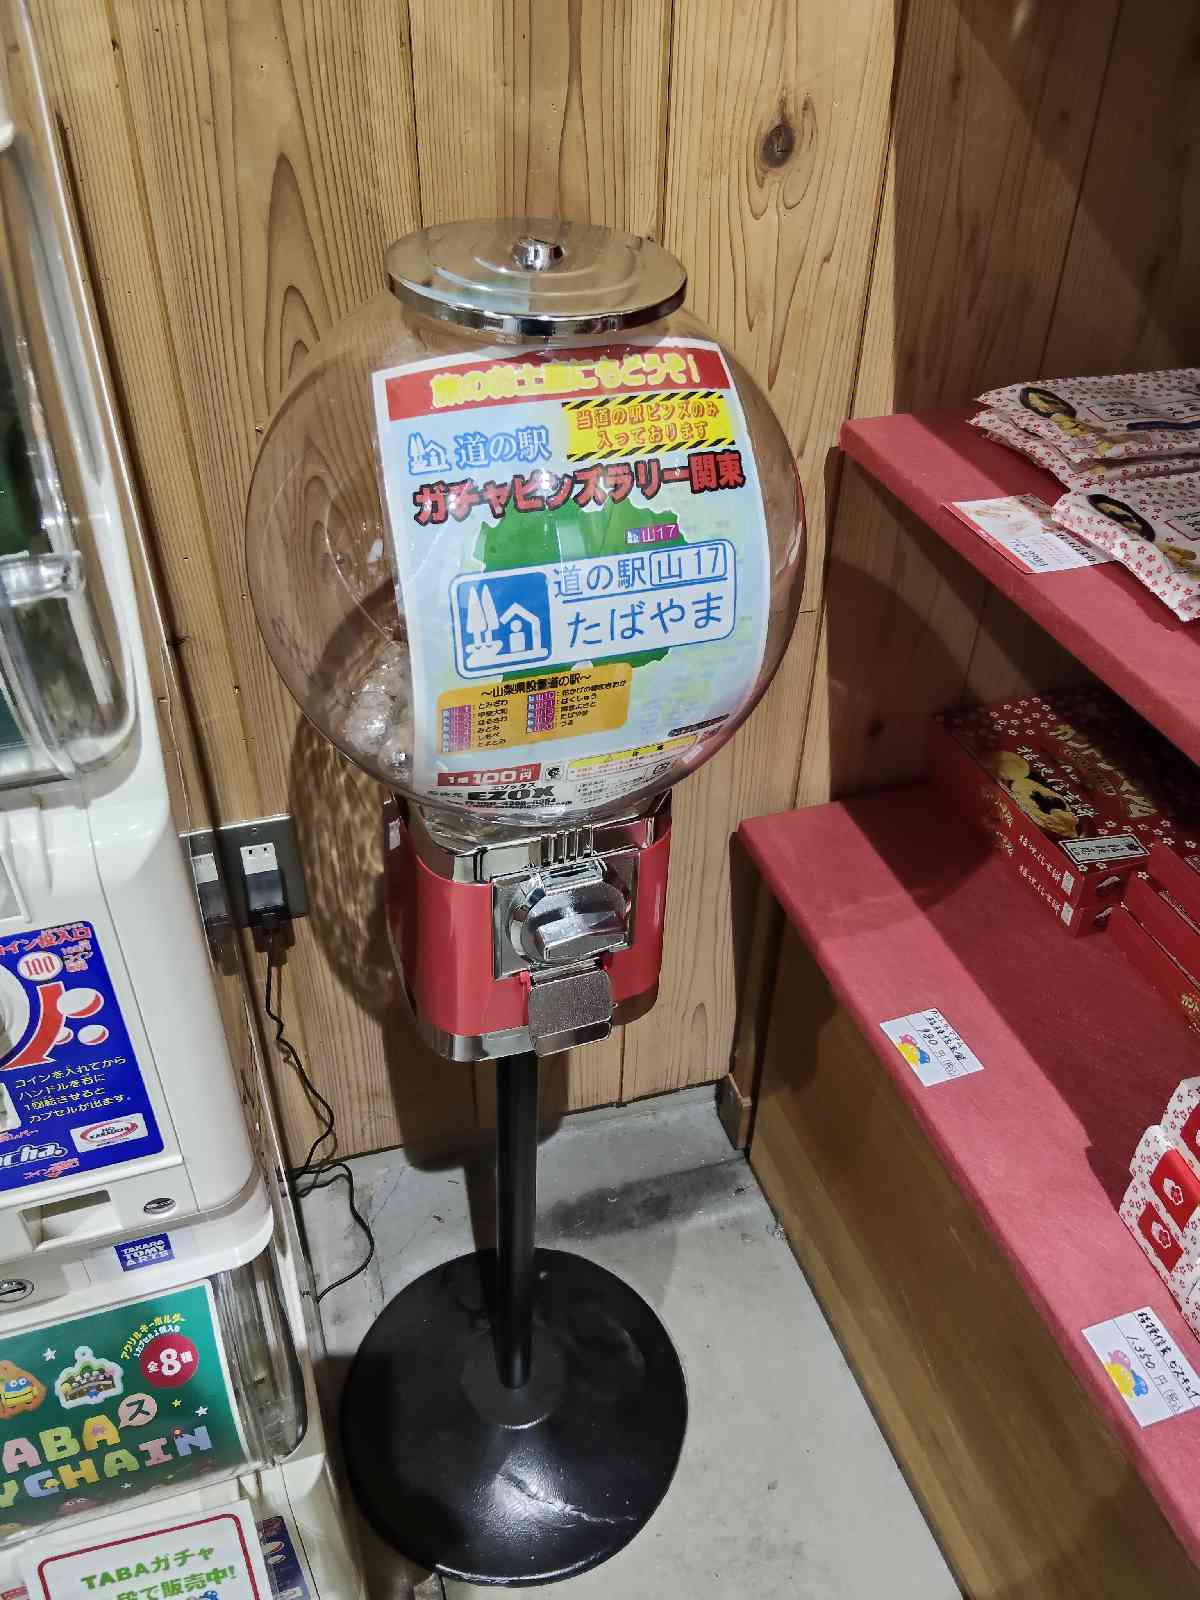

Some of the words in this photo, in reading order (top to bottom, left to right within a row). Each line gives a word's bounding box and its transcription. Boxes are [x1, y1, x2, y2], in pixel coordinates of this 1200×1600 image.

[576, 398, 721, 431] 当道の駅ピンズのみ
[454, 425, 552, 468] 道の駅
[597, 420, 709, 449] 入っております
[412, 450, 746, 526] ガチャピンズラリー関東
[553, 560, 646, 598] 道の駅
[567, 592, 724, 648] たばやま
[15, 1056, 127, 1088] コインを入れてから
[121, 1239, 165, 1255] TAKARA
[124, 1245, 165, 1260] TOMY
[120, 1312, 187, 1360] アクリルキーホルダー
